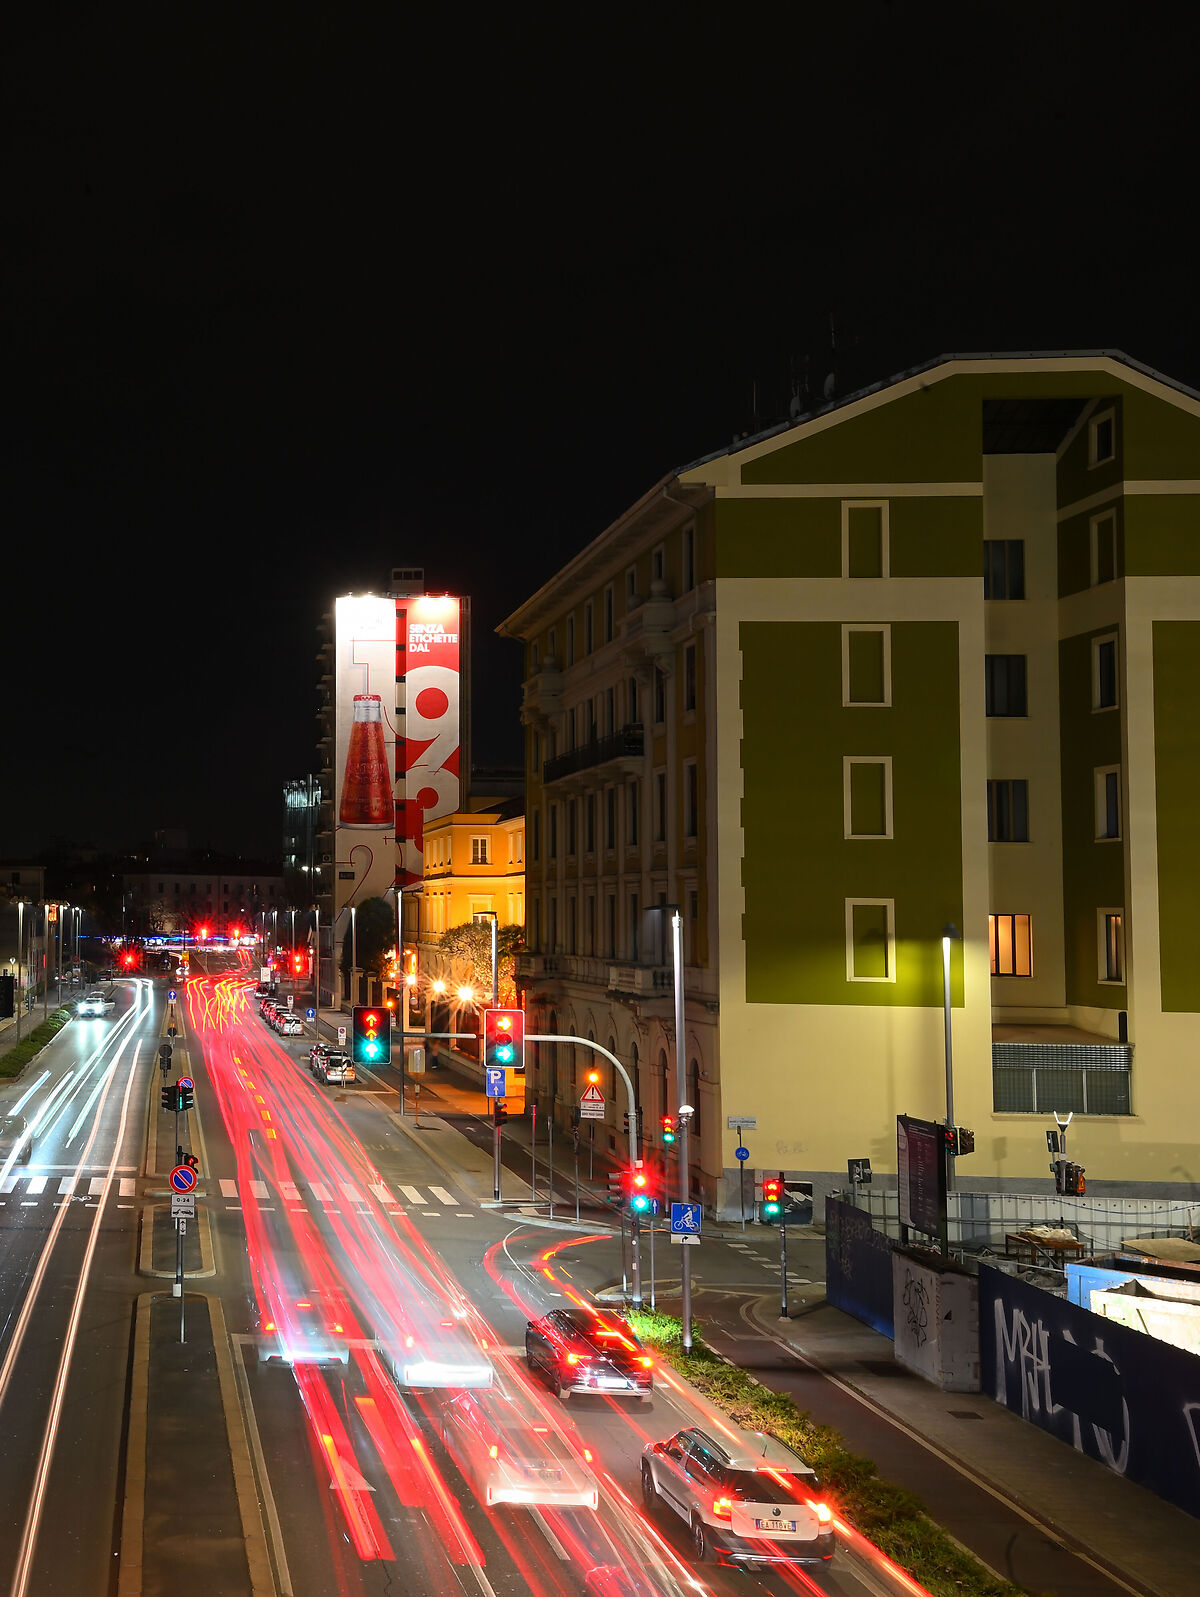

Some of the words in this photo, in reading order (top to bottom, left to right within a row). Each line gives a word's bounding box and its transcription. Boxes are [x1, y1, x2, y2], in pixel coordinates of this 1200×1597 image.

[409, 624, 445, 633] SENZA
[409, 634, 458, 643] ETICHETTE
[409, 643, 430, 653] DAL
[490, 1070, 502, 1084] P
